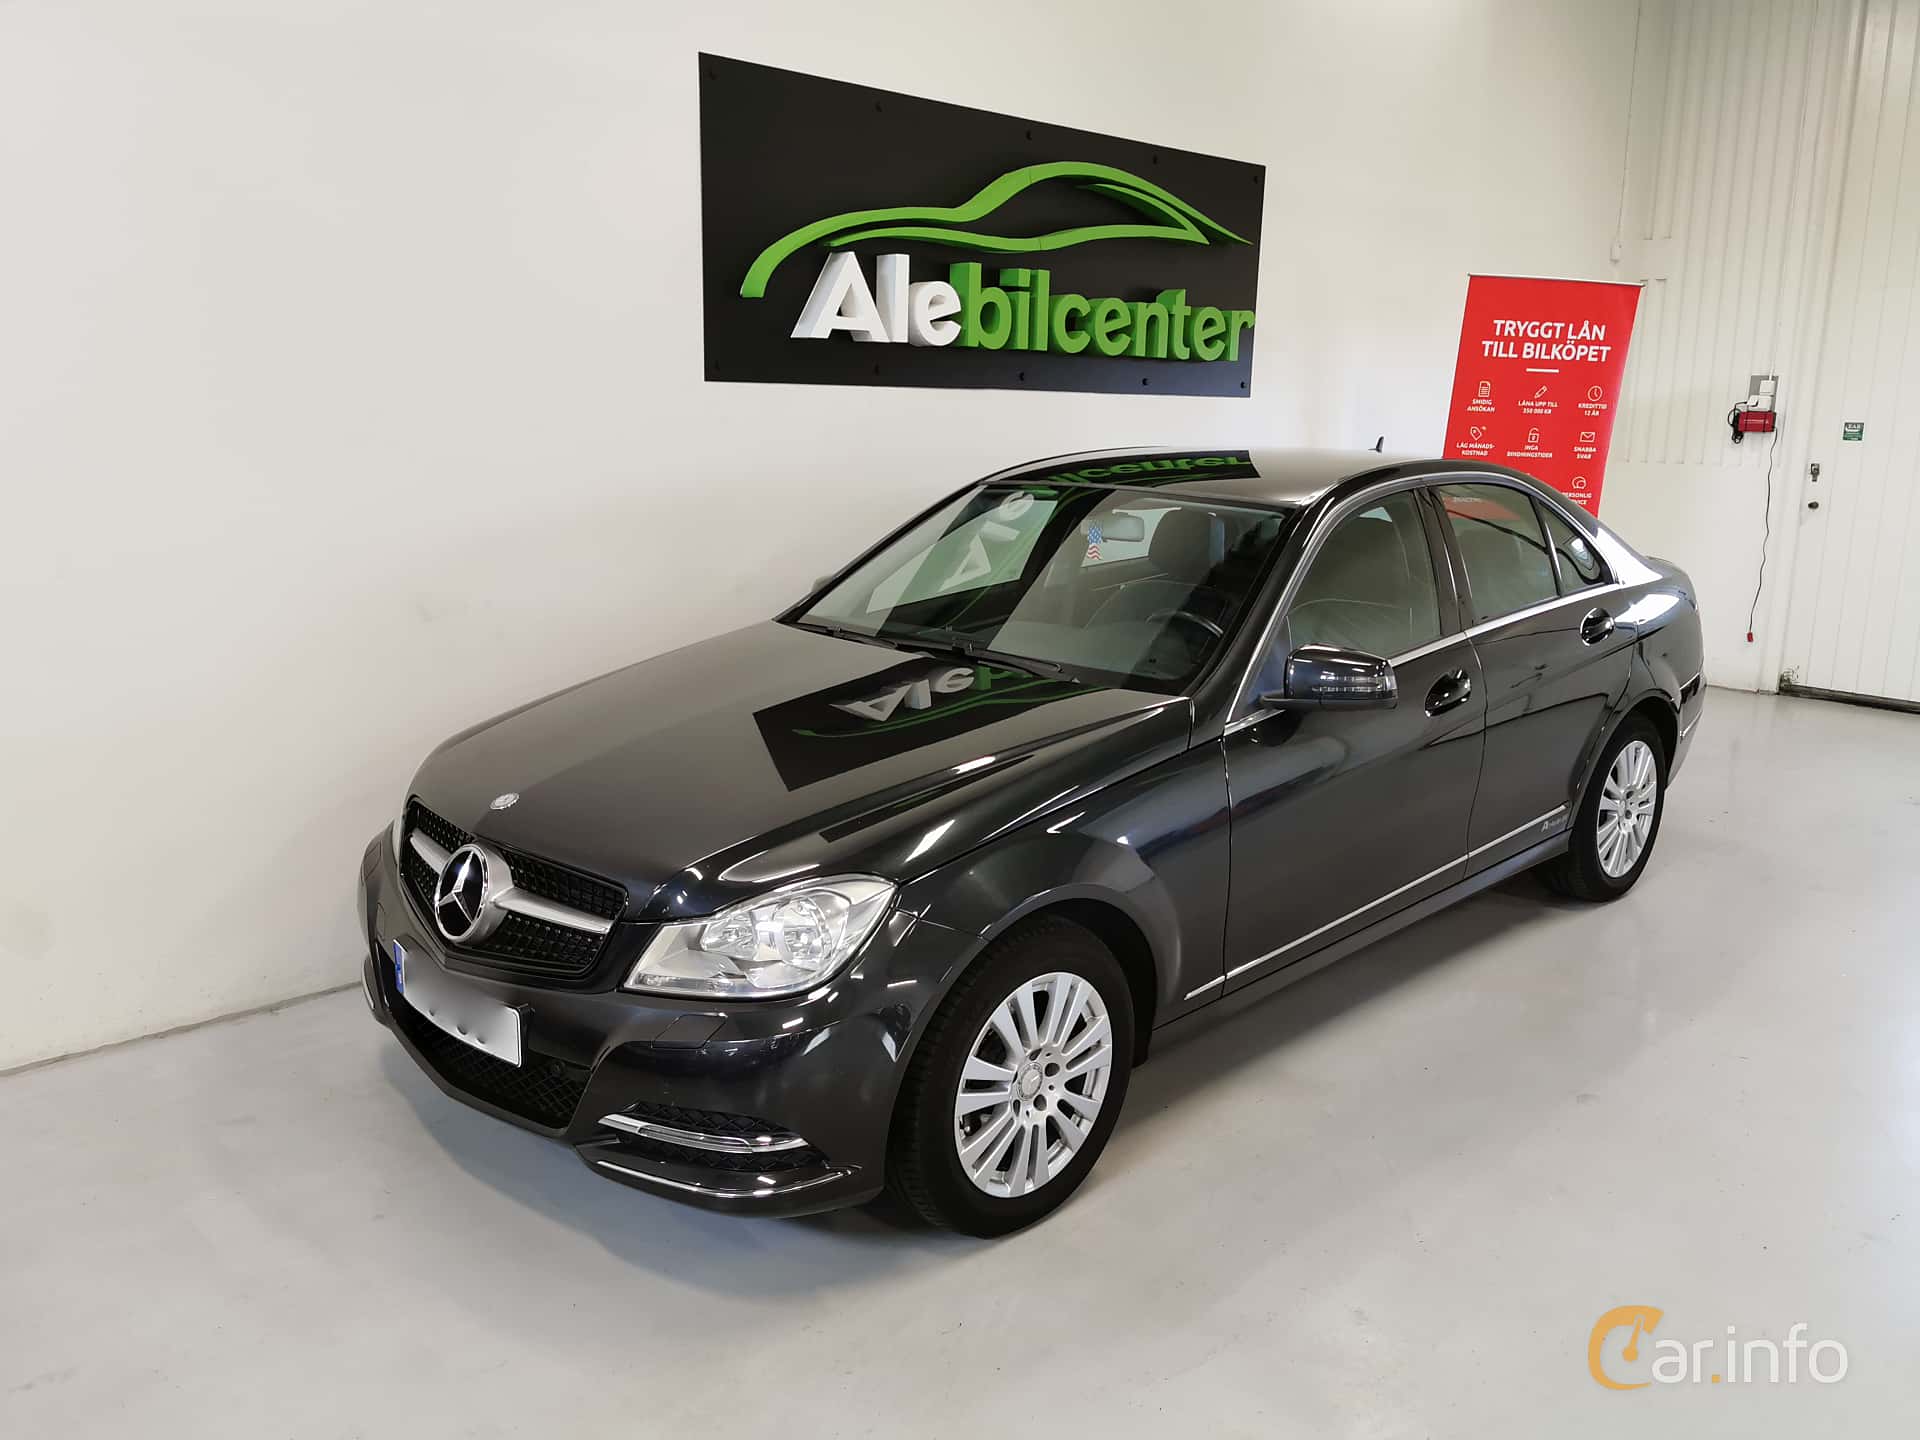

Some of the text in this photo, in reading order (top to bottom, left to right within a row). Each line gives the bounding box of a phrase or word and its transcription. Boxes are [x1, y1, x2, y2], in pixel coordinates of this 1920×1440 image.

[790, 250, 1256, 362] Alebilcenter
[1493, 319, 1606, 341] TRYGGT LÅN
[1482, 340, 1611, 362] TILL BILKÖPET
